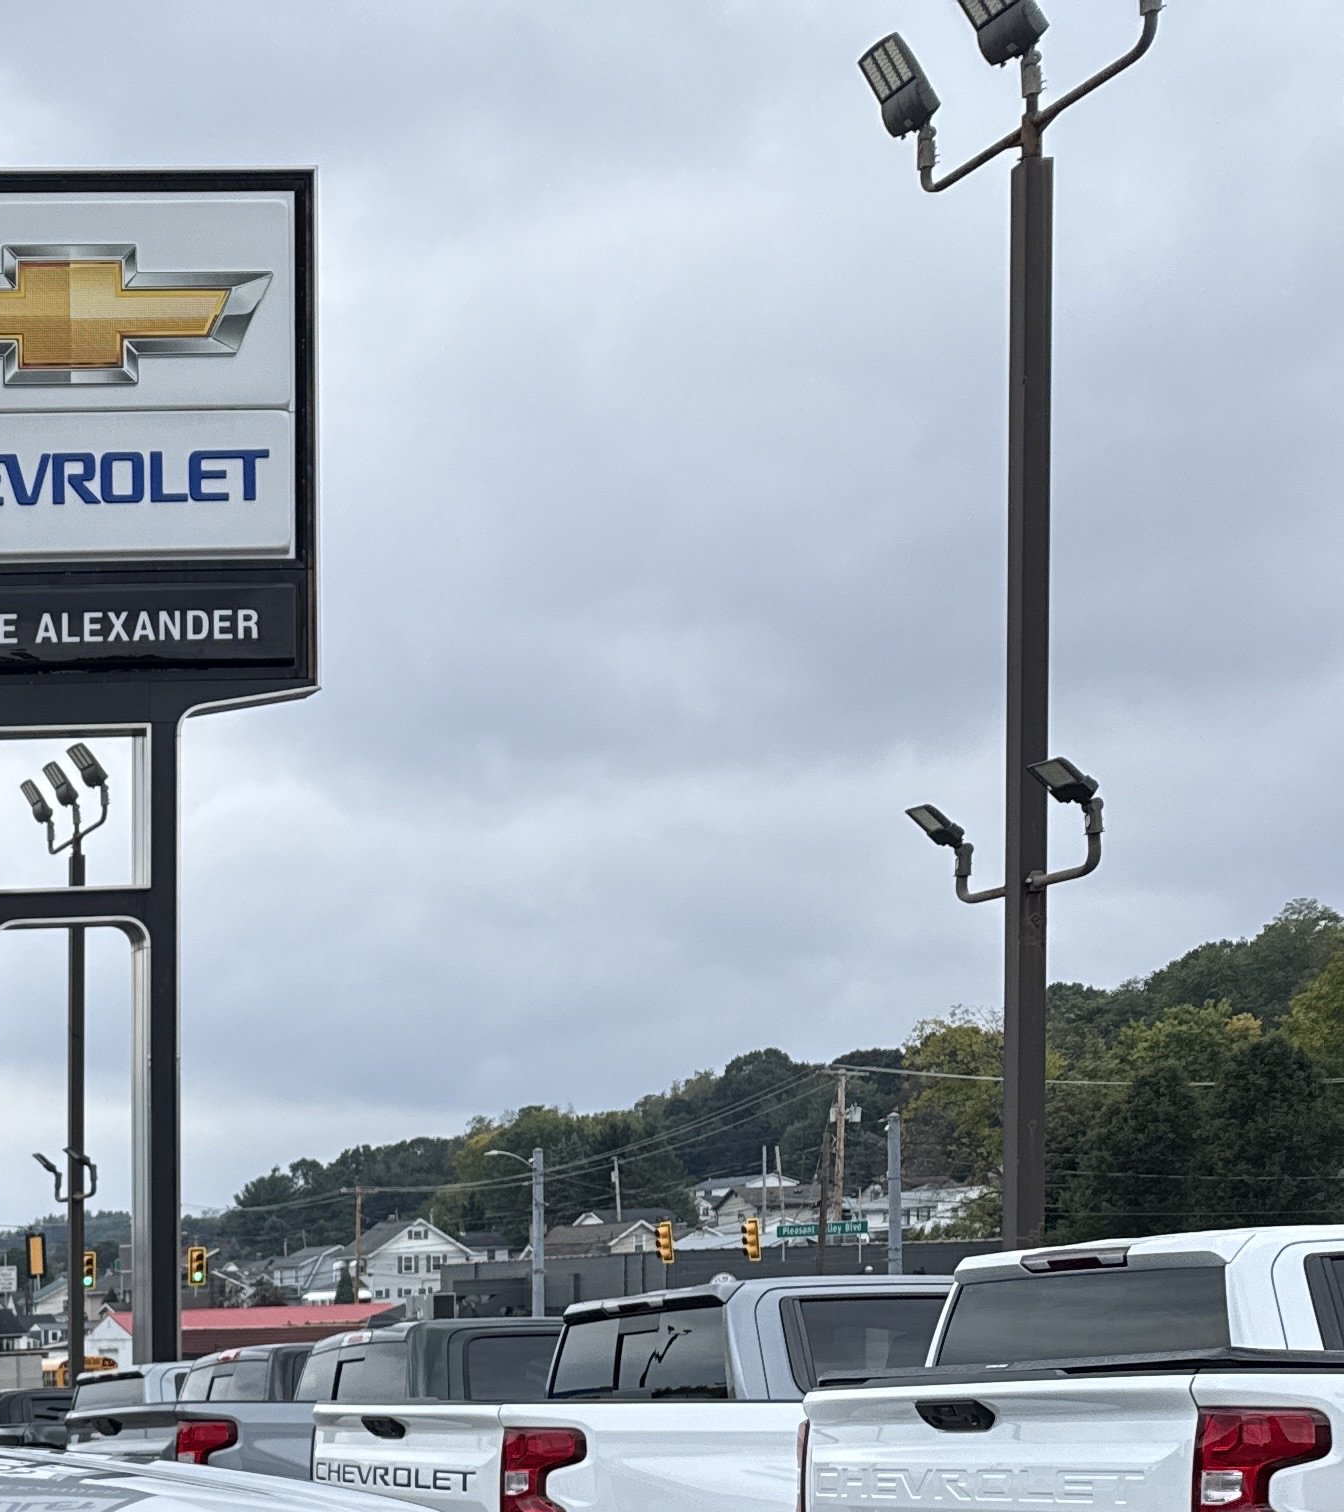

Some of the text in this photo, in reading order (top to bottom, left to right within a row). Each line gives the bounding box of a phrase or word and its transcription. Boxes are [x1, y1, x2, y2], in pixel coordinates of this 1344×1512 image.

[35, 608, 259, 643] ALEXANDER
[782, 1224, 816, 1235] Pleasant
[844, 1223, 862, 1233] Blvd
[315, 1461, 477, 1492] CHEVROLET
[814, 1467, 1145, 1505] CHEVROLET
